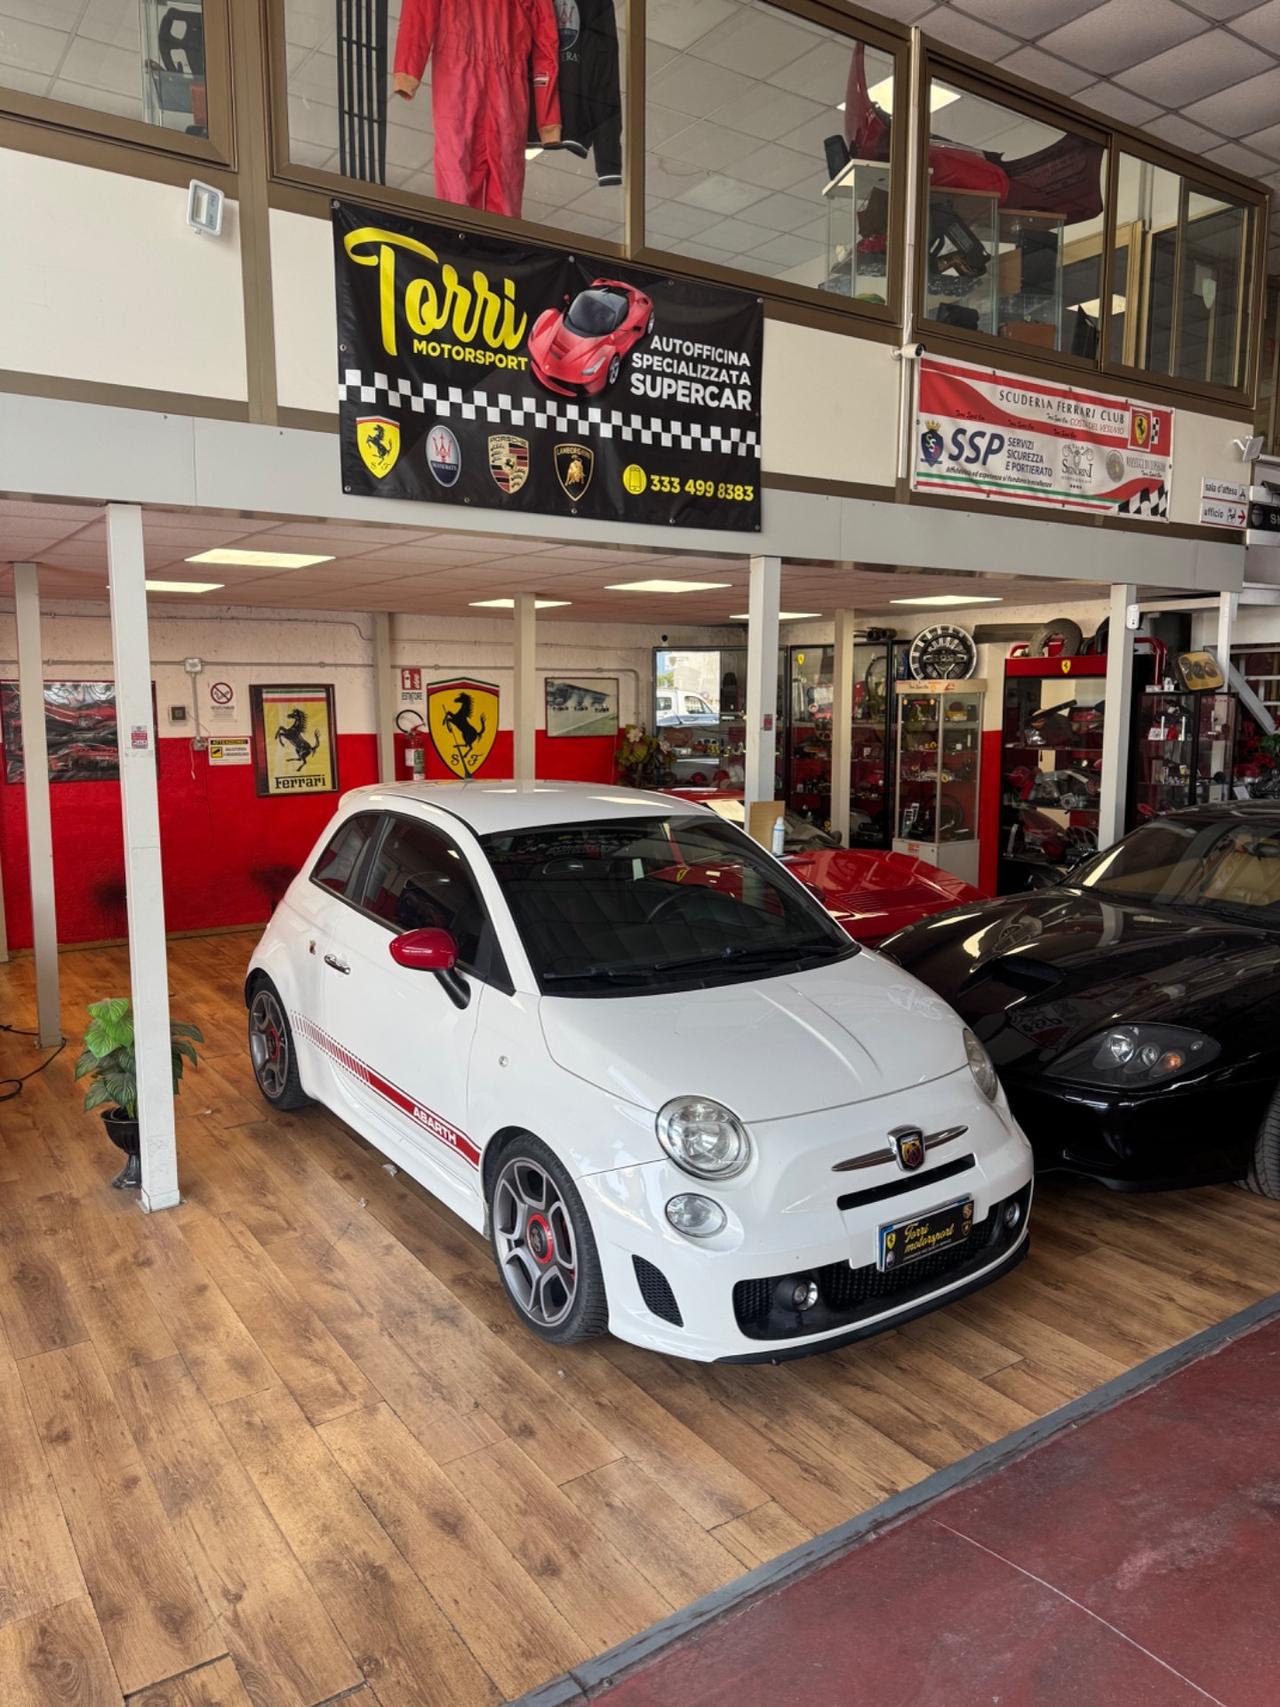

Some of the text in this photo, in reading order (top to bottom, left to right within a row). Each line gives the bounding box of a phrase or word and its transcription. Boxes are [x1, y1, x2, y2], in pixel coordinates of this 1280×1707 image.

[343, 226, 528, 356] Torri
[412, 339, 528, 371] MOTORSPORT
[649, 334, 751, 367] AUTOFFICINA
[631, 352, 751, 386] SPECIALIZZATA
[630, 372, 752, 411] SUPERCAR
[999, 390, 1053, 410] SCUDERIA
[1057, 401, 1096, 419] FERRARI
[1100, 410, 1124, 424] CLUB
[948, 427, 1005, 466] SSP
[1006, 449, 1044, 463] SICUREZZA
[1007, 437, 1034, 450] SERVIZI
[1005, 461, 1053, 477] E PORTIERATO
[650, 475, 754, 501] 333 499 8383
[1204, 507, 1223, 518] ufficio
[274, 774, 326, 790] Ferrari
[412, 1106, 457, 1145] ABARTH
[904, 1221, 930, 1243] Torri
[904, 1223, 955, 1254] motorsport
